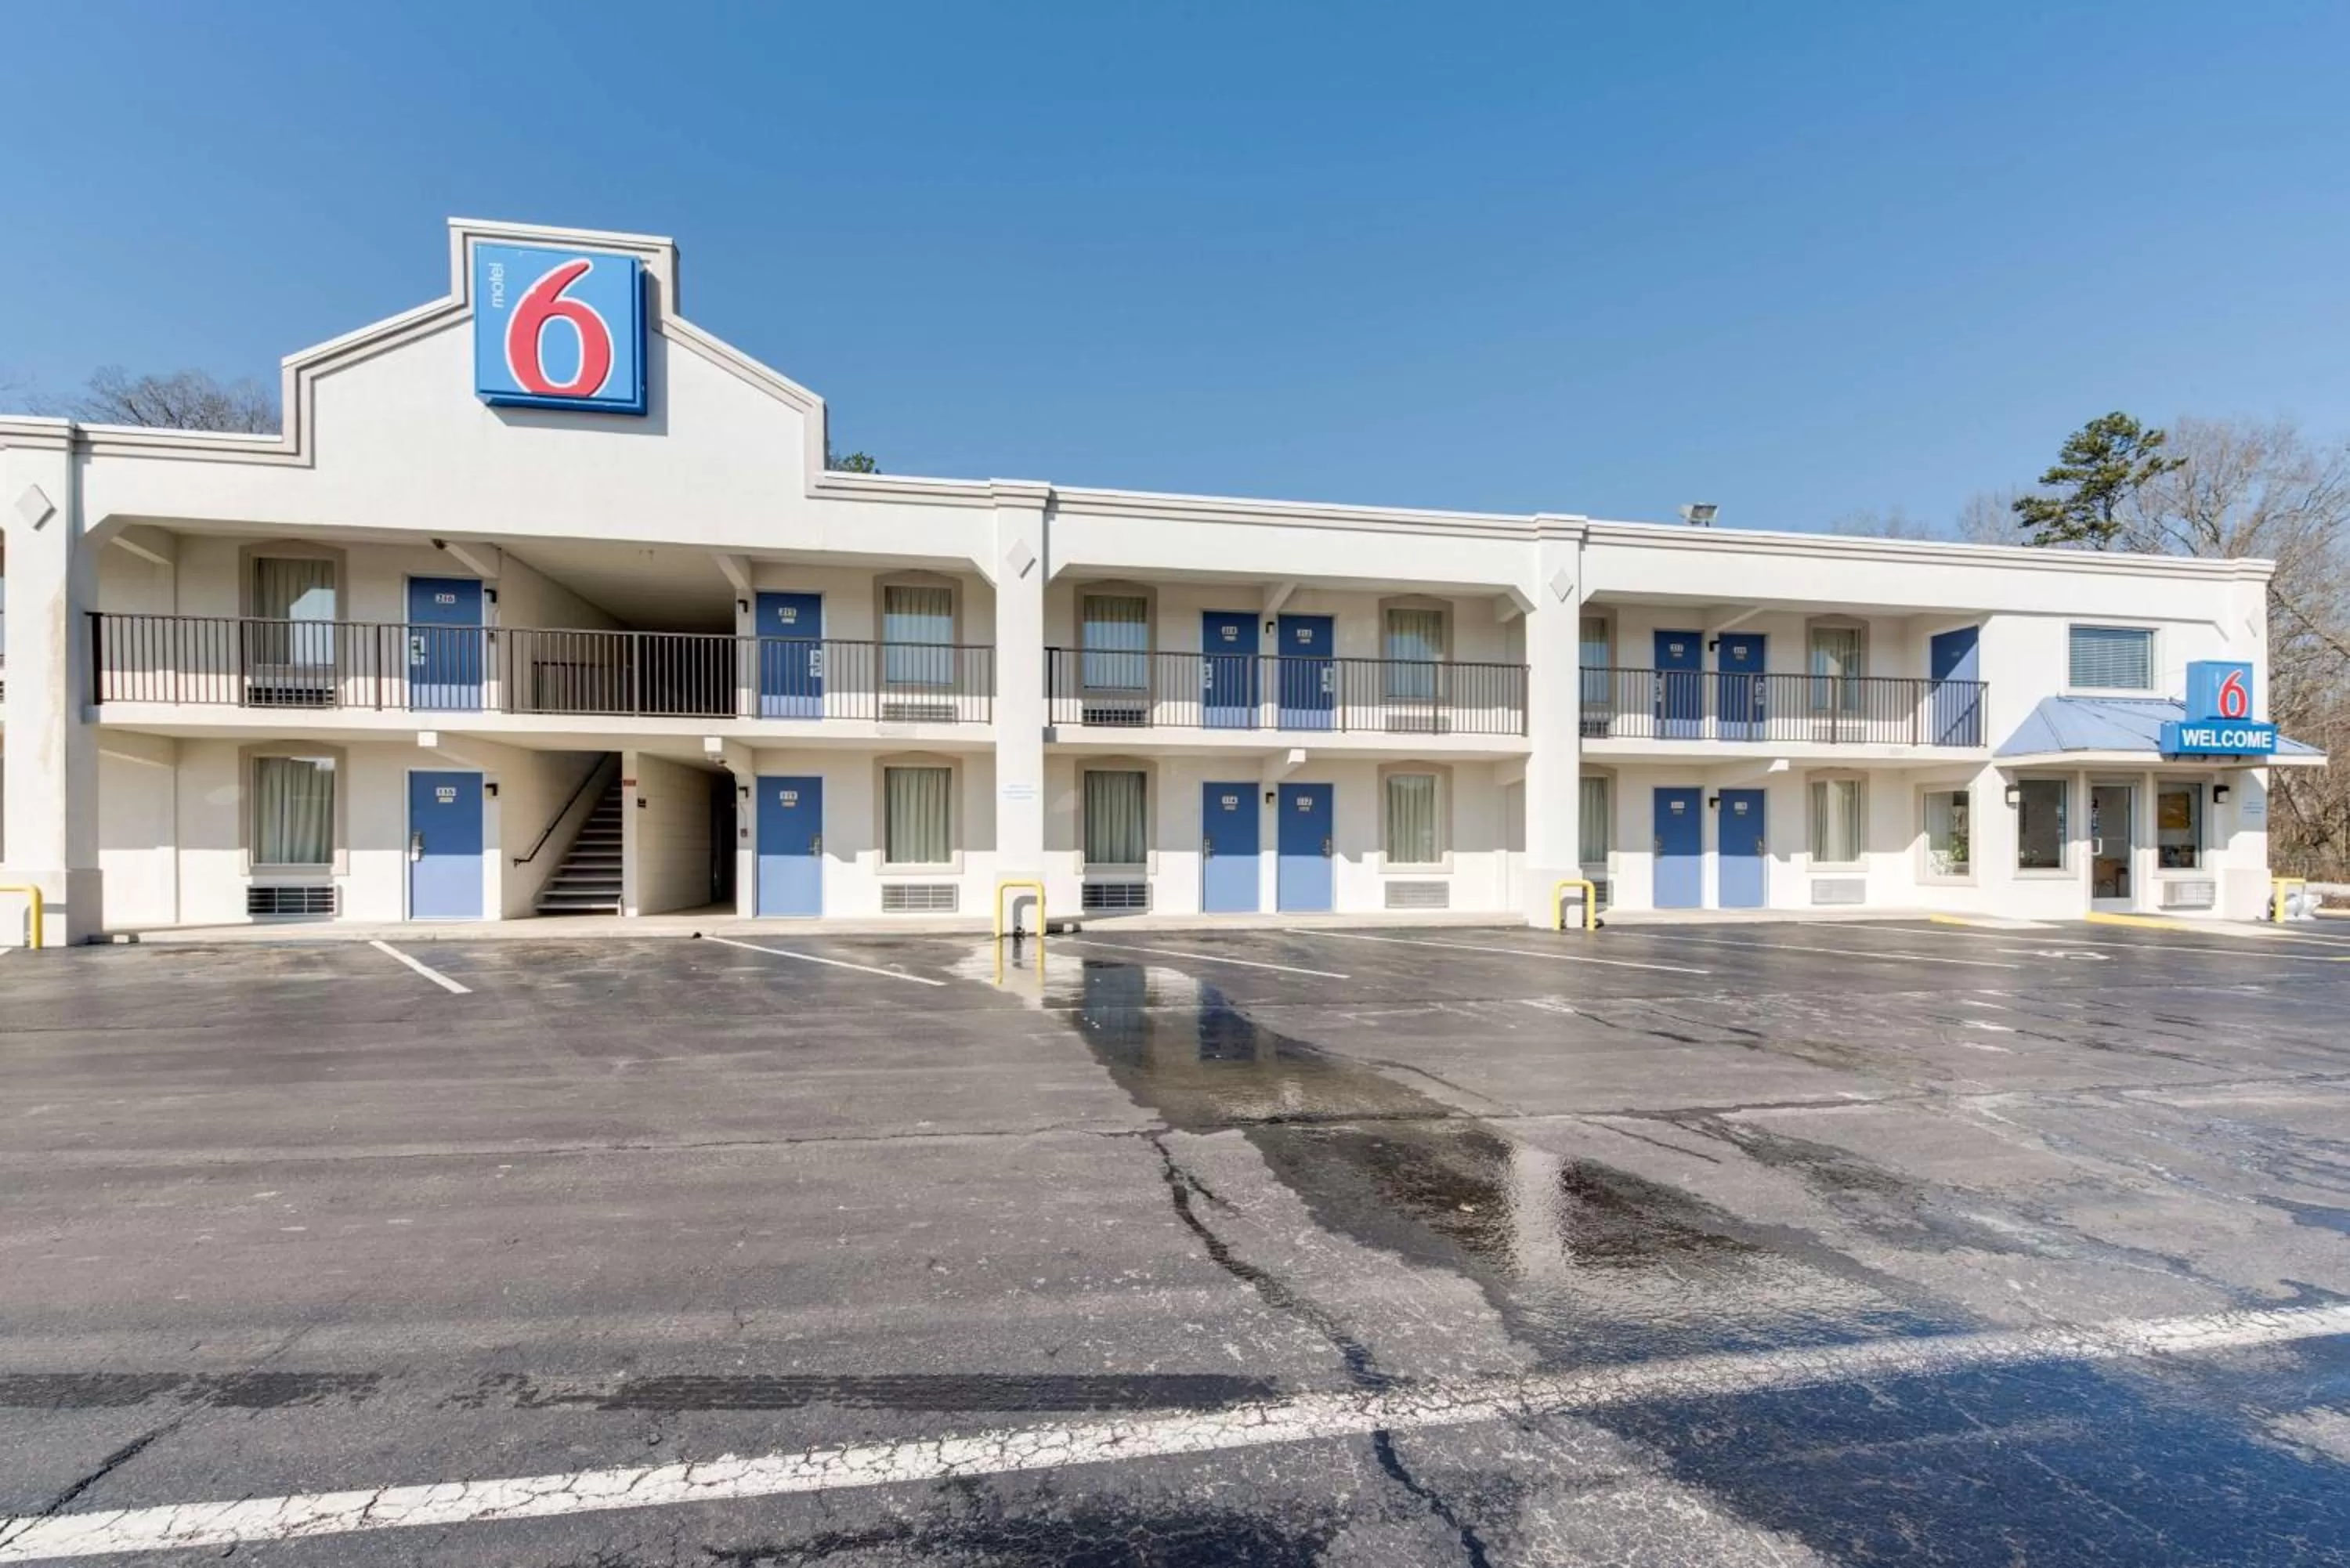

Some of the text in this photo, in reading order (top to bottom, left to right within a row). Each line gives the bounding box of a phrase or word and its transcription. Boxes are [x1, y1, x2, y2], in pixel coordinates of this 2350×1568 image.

[488, 262, 505, 309] motel
[504, 258, 615, 398] 6
[2218, 669, 2248, 718] 6
[2182, 728, 2272, 749] WELCOME
